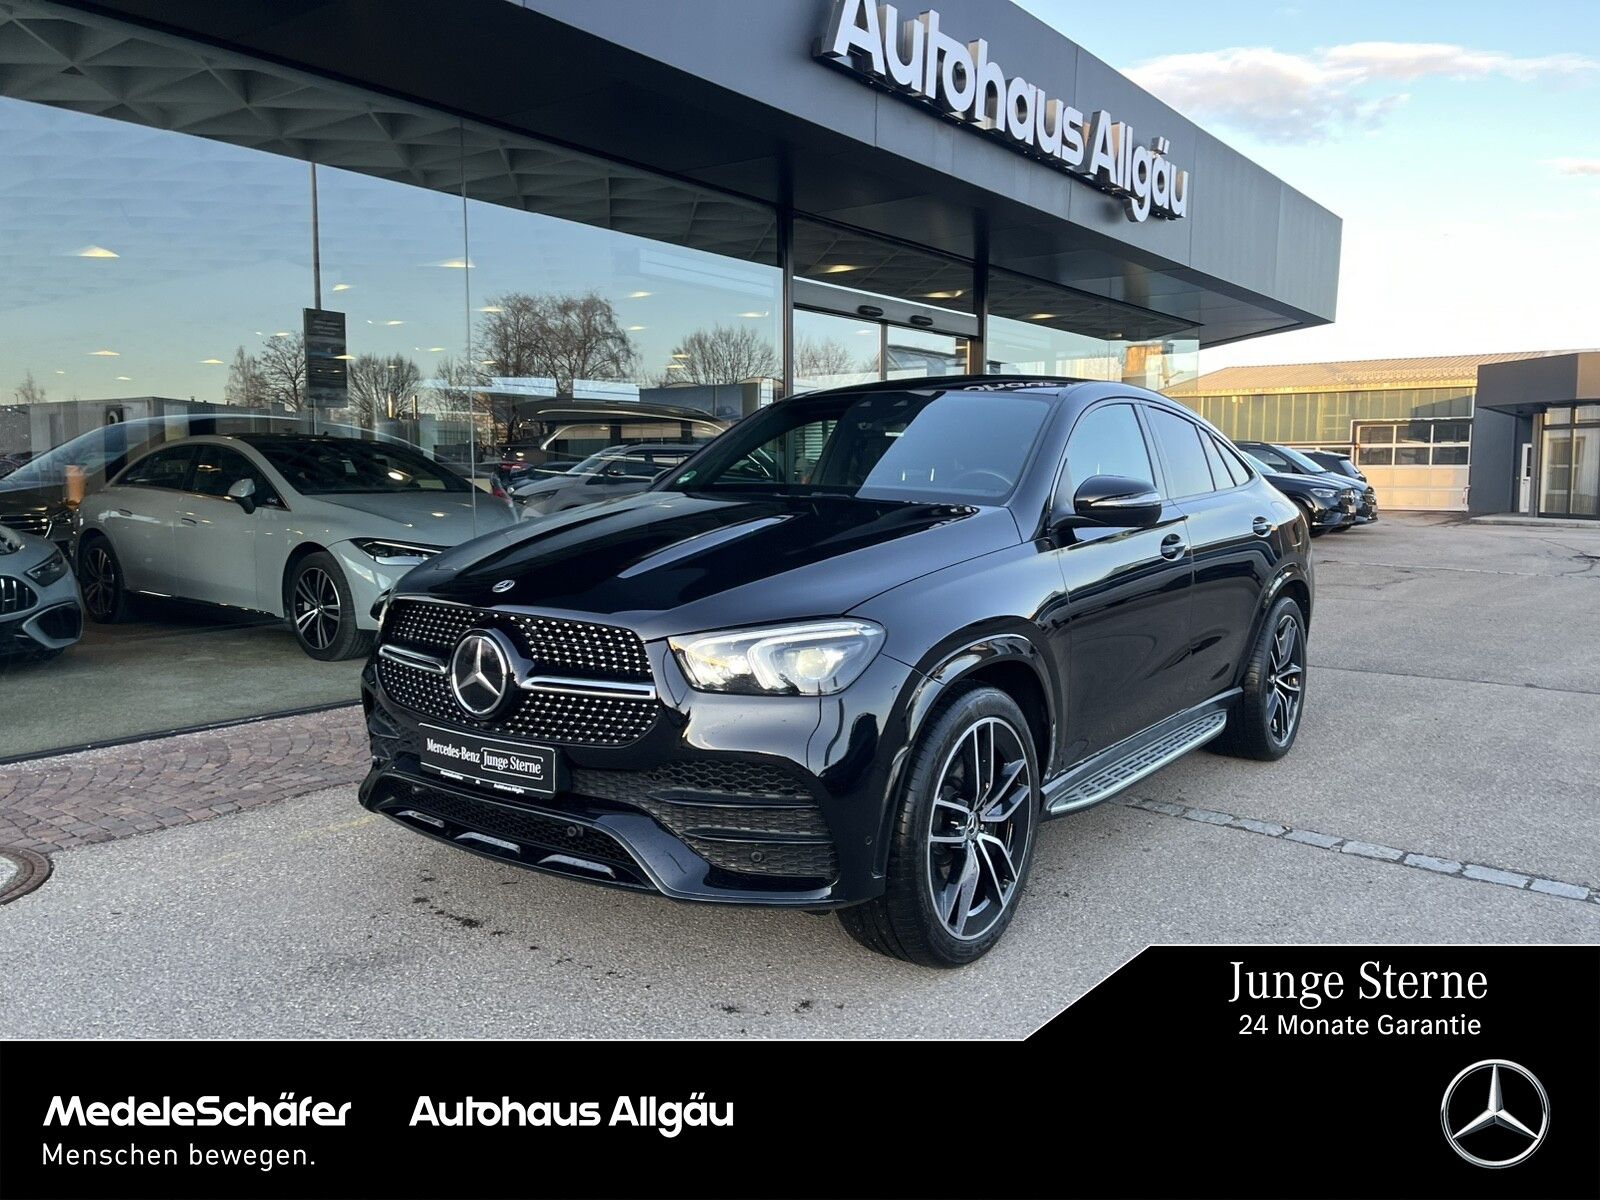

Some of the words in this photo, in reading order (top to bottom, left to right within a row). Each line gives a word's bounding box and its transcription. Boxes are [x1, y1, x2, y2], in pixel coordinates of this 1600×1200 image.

[828, 0, 1084, 166] Autohaus
[1089, 110, 1189, 223] Allgäu
[426, 738, 480, 763] Mercedes-Benz
[483, 751, 508, 770] Junge
[510, 757, 541, 774] Sterne
